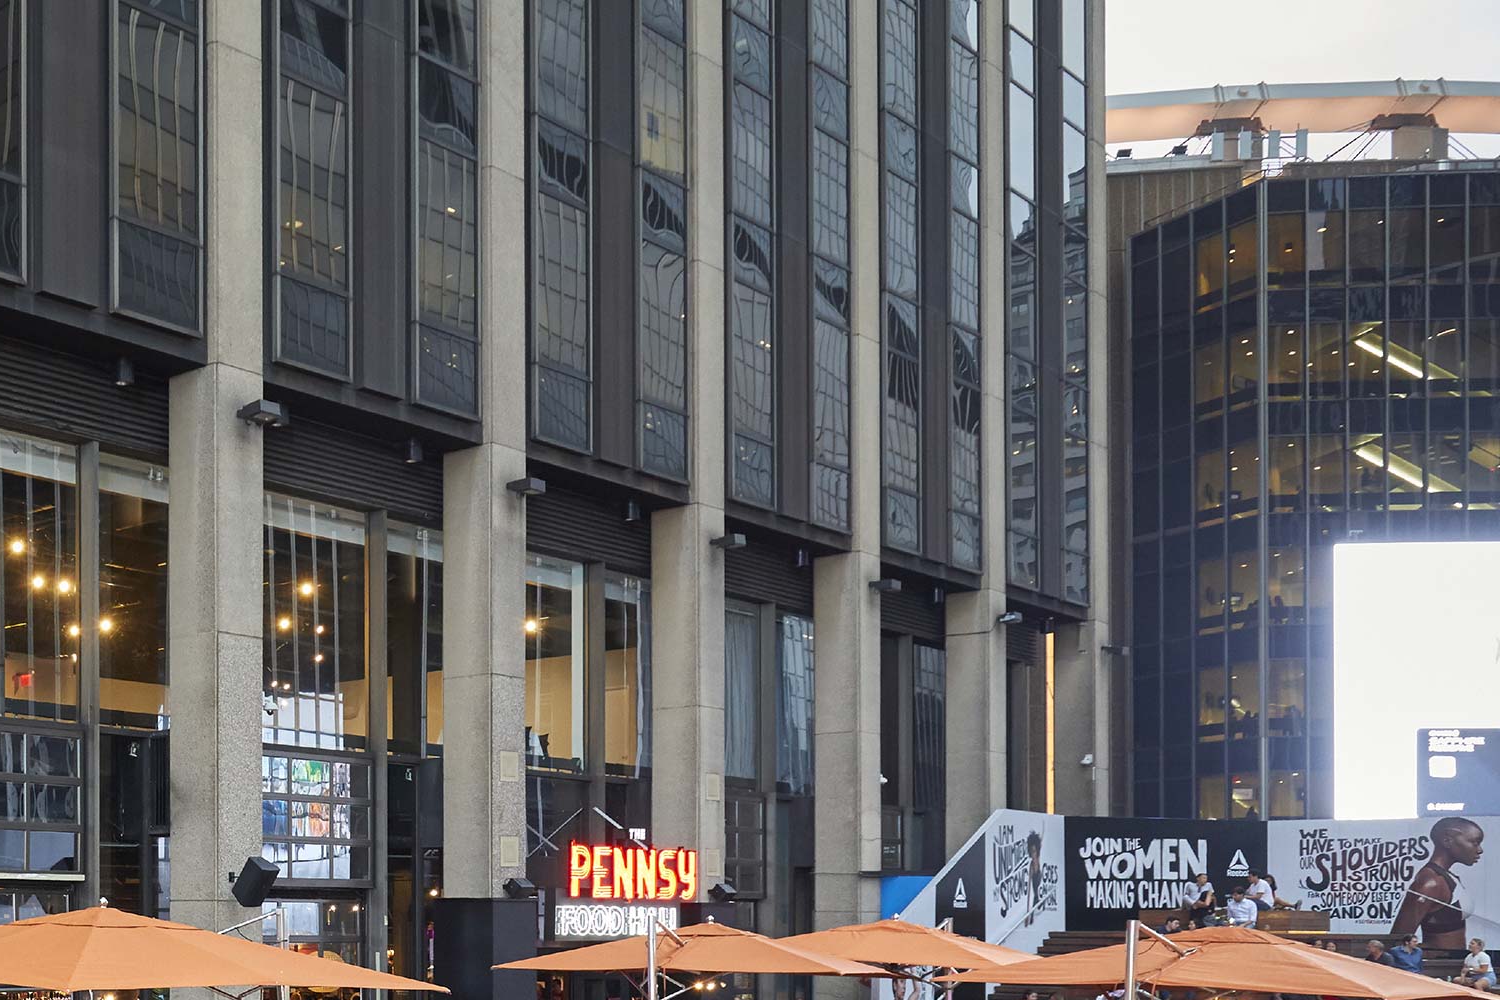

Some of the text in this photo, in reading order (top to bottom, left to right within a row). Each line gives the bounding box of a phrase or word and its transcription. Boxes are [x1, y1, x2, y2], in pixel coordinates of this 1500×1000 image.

[629, 828, 646, 840] THE
[1299, 829, 1328, 839] WE
[1079, 836, 1141, 858] JOIN THE
[1299, 837, 1381, 856] HAVE TO MAKE
[1084, 838, 1208, 880] WOMEN
[1300, 836, 1430, 892] OUR SHOULDERS
[1348, 856, 1414, 882] STRONG
[569, 842, 697, 901] PENNSY
[1086, 880, 1189, 909] MAKING CHAN
[1330, 882, 1405, 892] ENOUGH
[1320, 891, 1370, 908] SOMEBODY
[1371, 891, 1389, 903] ELSE
[1389, 891, 1401, 900] TO
